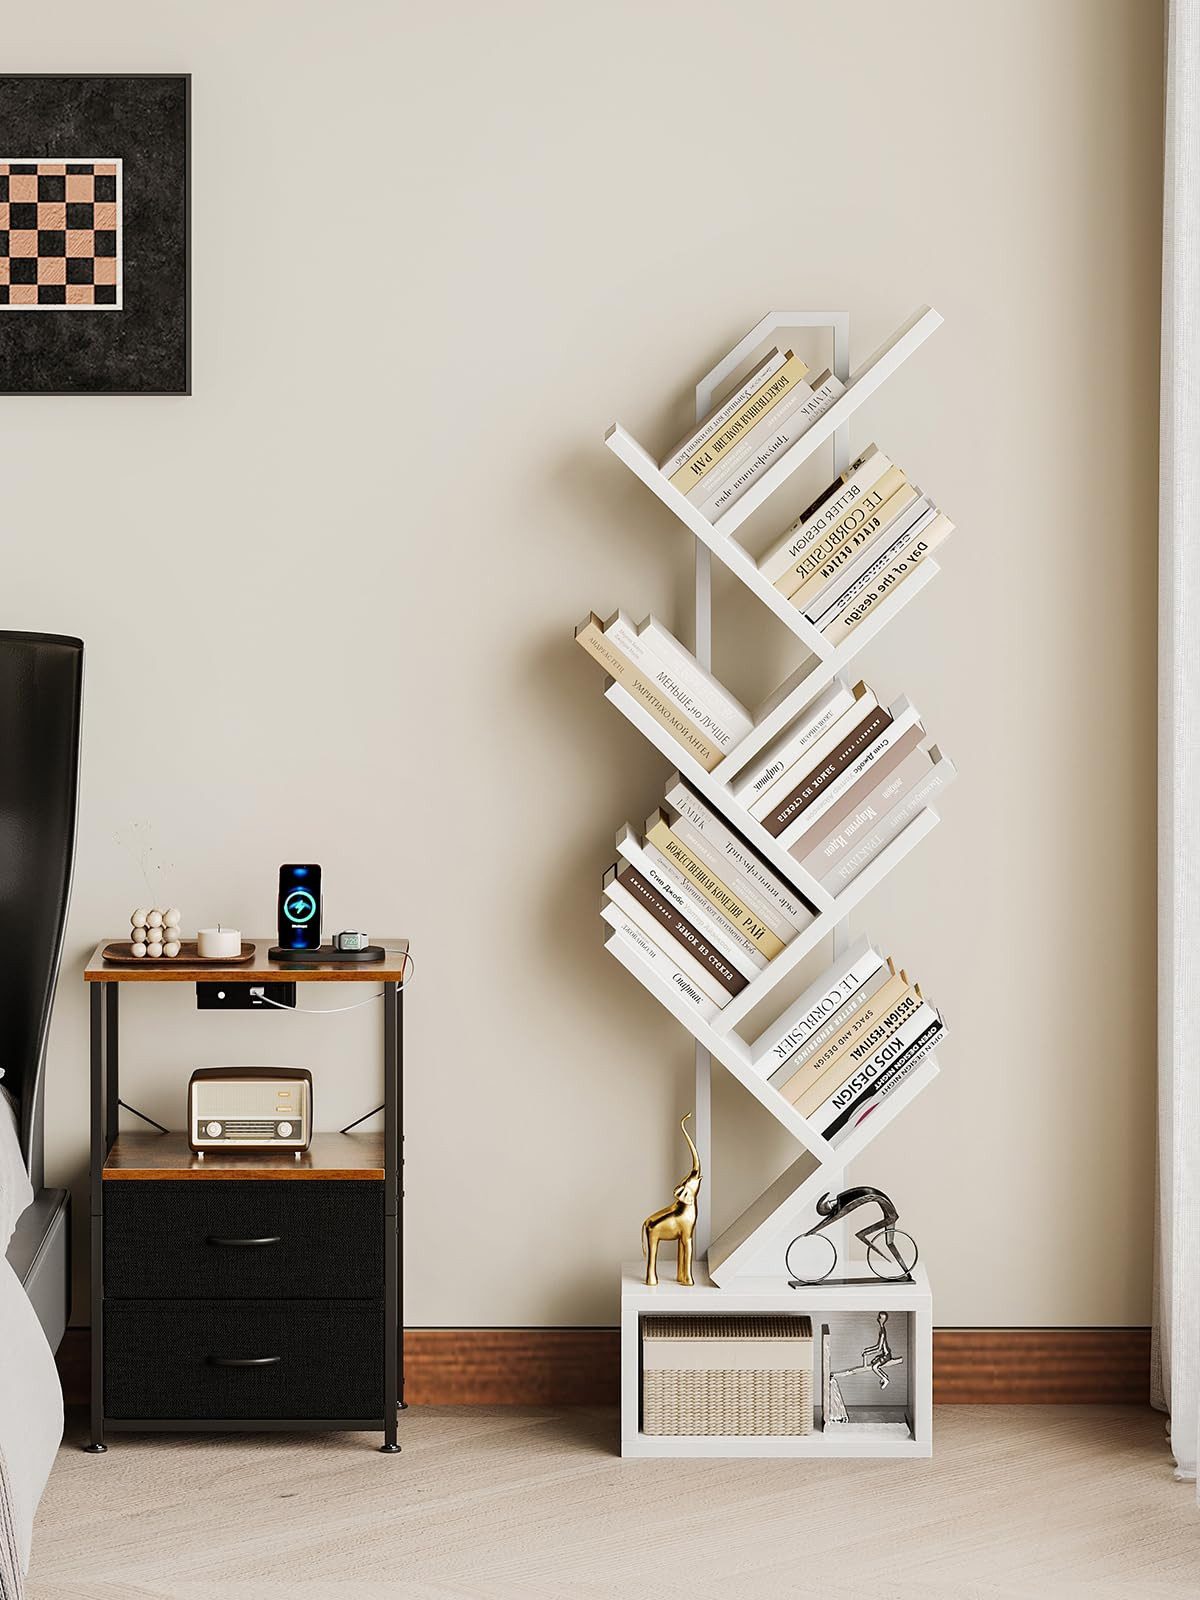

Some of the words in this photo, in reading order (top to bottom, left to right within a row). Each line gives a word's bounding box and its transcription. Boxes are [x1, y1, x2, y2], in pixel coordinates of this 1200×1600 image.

[739, 375, 789, 425] БОЖЕСТВЕННАЯ
[712, 420, 744, 452] КОМЕДИЯ
[690, 452, 712, 475] РАЙ
[733, 435, 789, 488] Триумфальная
[715, 489, 732, 507] арка
[700, 716, 730, 745] ЛУЧШЕ
[687, 735, 710, 758] АНГЕЛ
[854, 752, 874, 773] Джобс
[753, 761, 784, 792] Спартак
[812, 764, 836, 788] замок
[777, 798, 802, 822] стекла
[844, 806, 877, 836] Мартин
[823, 834, 847, 857] Иден
[650, 868, 664, 885] Стив
[663, 884, 683, 905] Джобс
[664, 841, 715, 890] БОЖЕСТВЕННАЯ
[710, 886, 743, 918] КОМЕДИЯ
[742, 918, 765, 940] РАЙ
[725, 842, 778, 897] Триумфальная
[779, 898, 797, 915] арка
[674, 921, 699, 946] замок
[697, 944, 709, 956] из
[706, 954, 734, 980] стекла
[742, 940, 756, 954] Боб
[672, 973, 703, 1004] Спартак
[839, 973, 858, 990] LE
[854, 991, 867, 1003] BE
[833, 1001, 857, 1025] BETTER
[852, 1010, 873, 1031] SPACE
[882, 996, 915, 1028] DESIGN
[773, 991, 841, 1058] CORBUSIER
[916, 1025, 939, 1046] OPEN
[792, 1024, 834, 1065] RENDERINGS
[838, 1030, 852, 1045] AND
[850, 1026, 885, 1060] FESTIVAL
[924, 1034, 943, 1051] OPEN
[814, 1045, 839, 1069] DESIGN
[874, 1037, 904, 1067] KIDS
[892, 1043, 920, 1070] DESIGN
[901, 1051, 925, 1075] DESIGN
[832, 1064, 877, 1109] DESIGN
[871, 1066, 896, 1090] NIGHT
[882, 1074, 901, 1095] NIGHT
